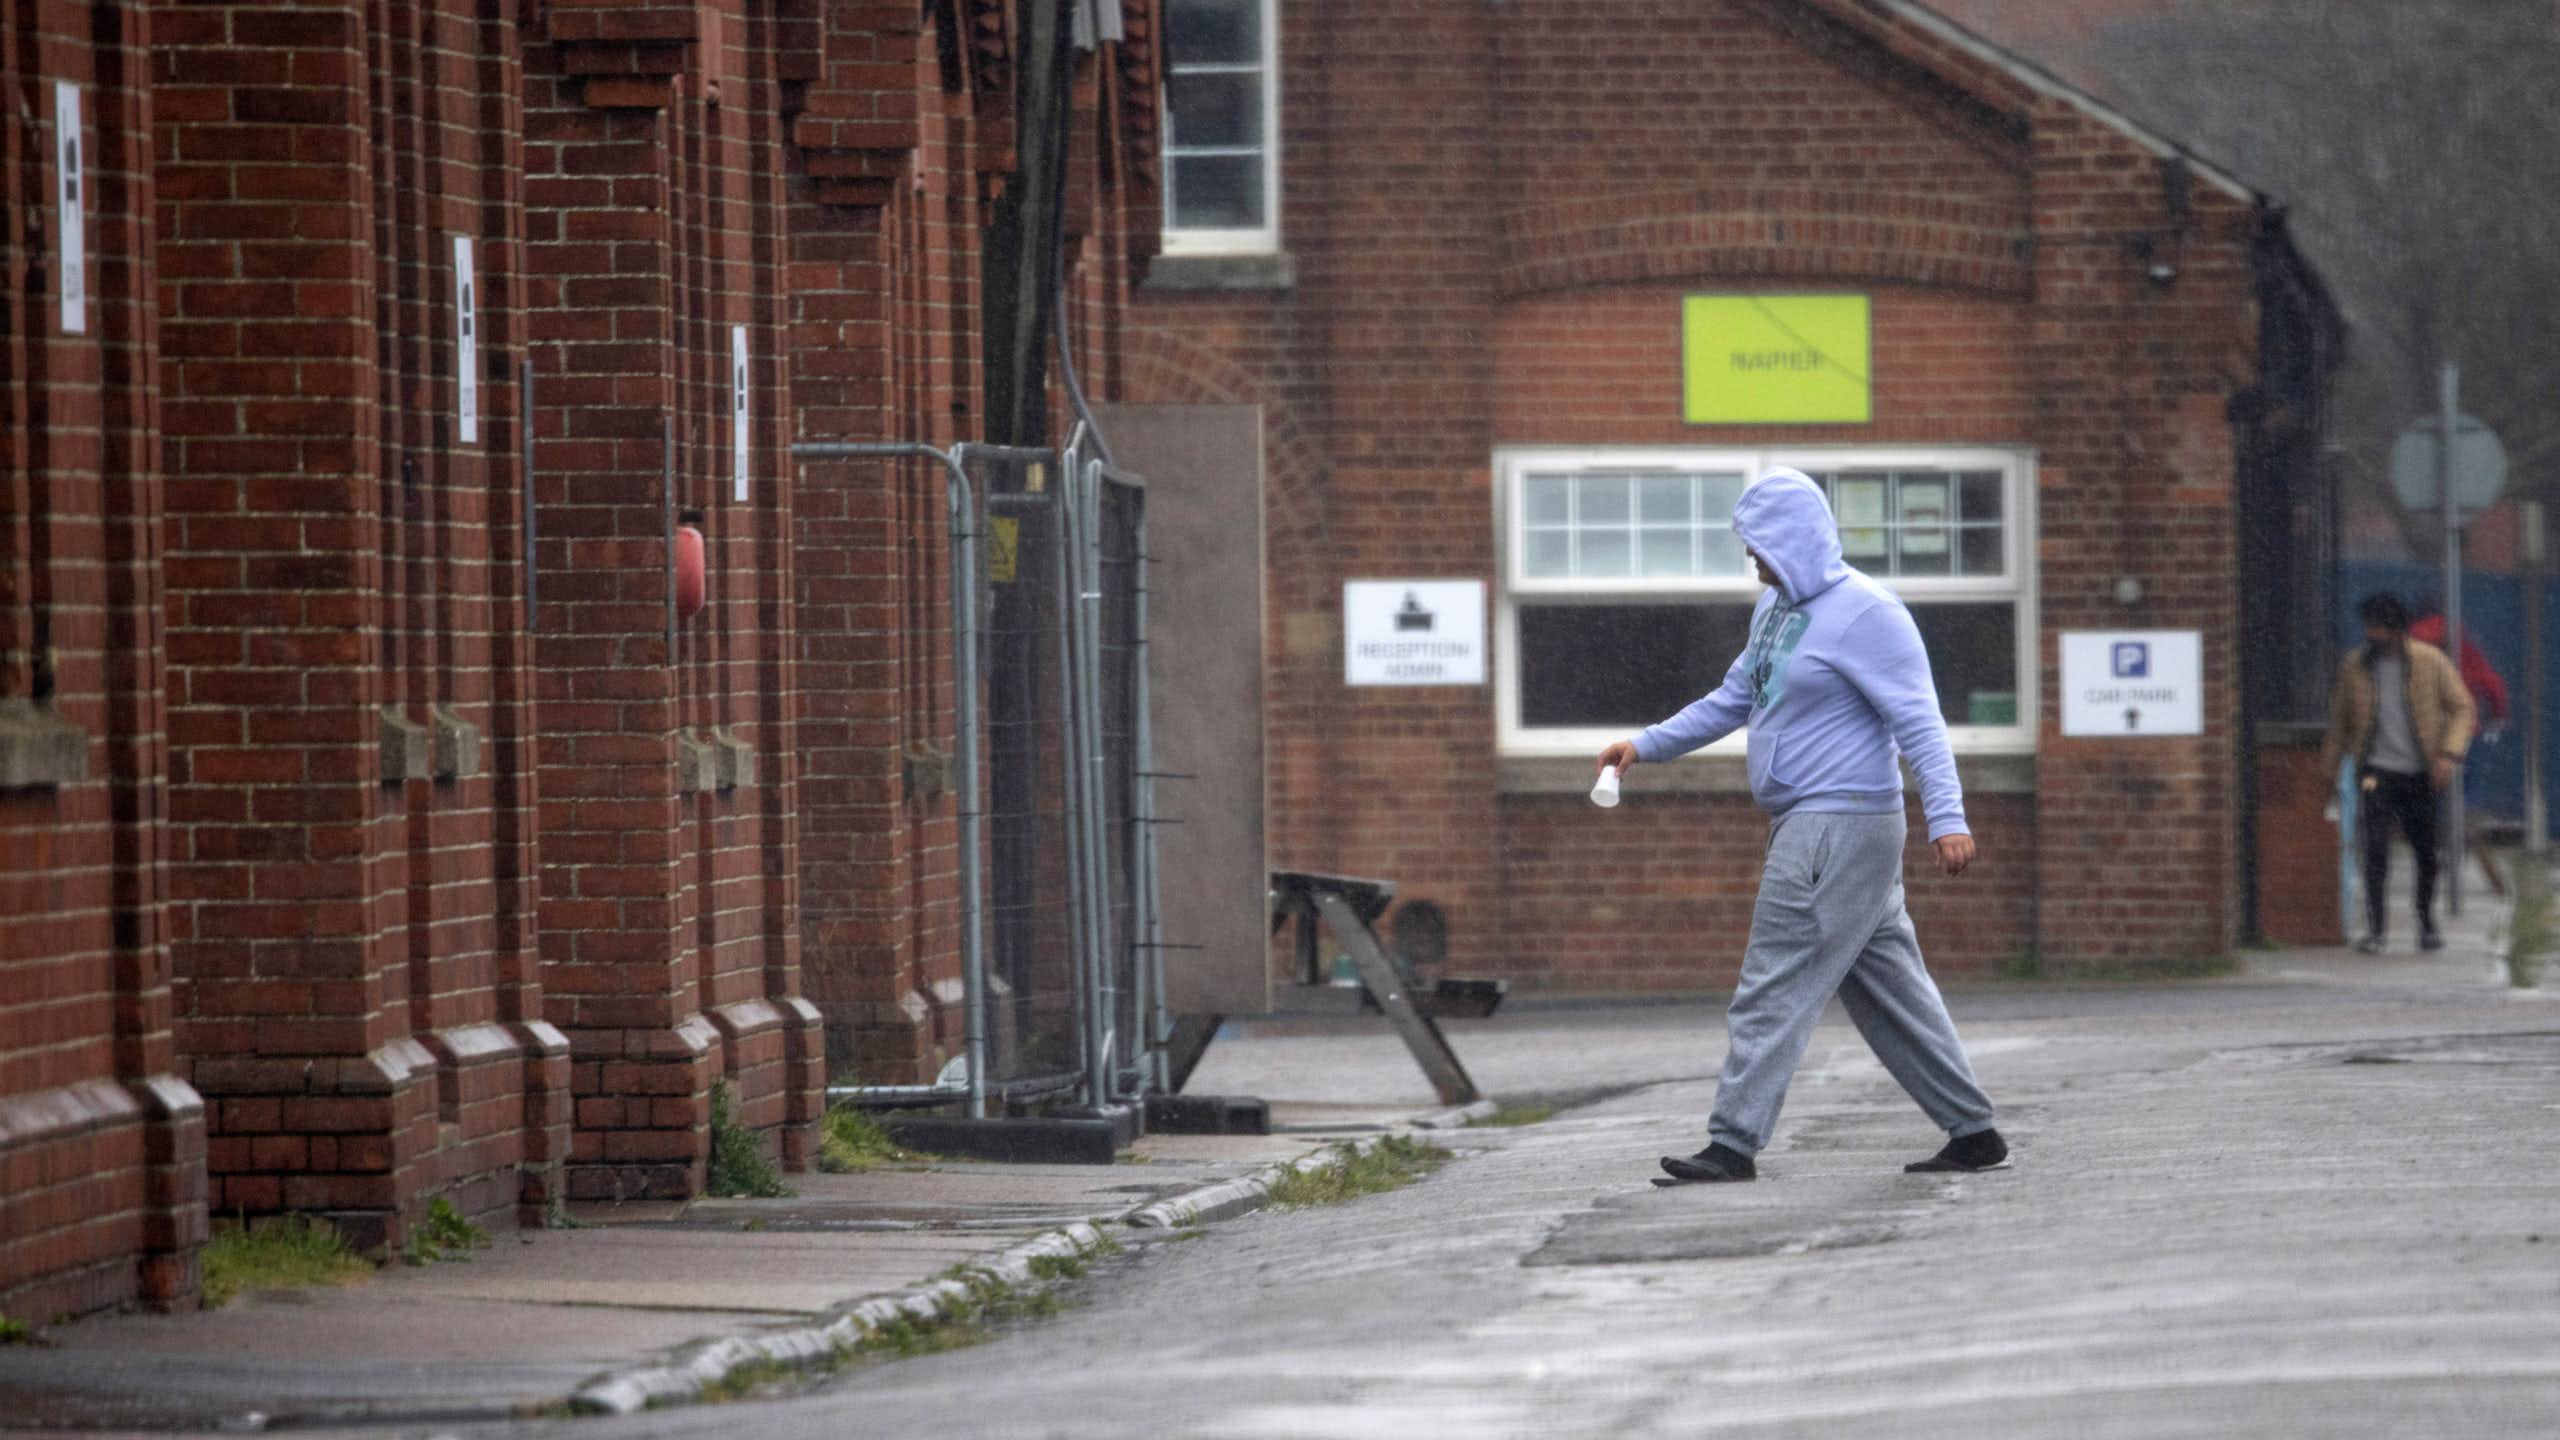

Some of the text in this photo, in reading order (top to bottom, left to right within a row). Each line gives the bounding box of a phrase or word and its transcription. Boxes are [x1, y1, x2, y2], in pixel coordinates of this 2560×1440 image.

[1730, 350, 1824, 371] NAPIER
[1357, 642, 1471, 658] RECEPTION
[2117, 646, 2144, 674] P
[2083, 688, 2177, 704] CAR PARK
